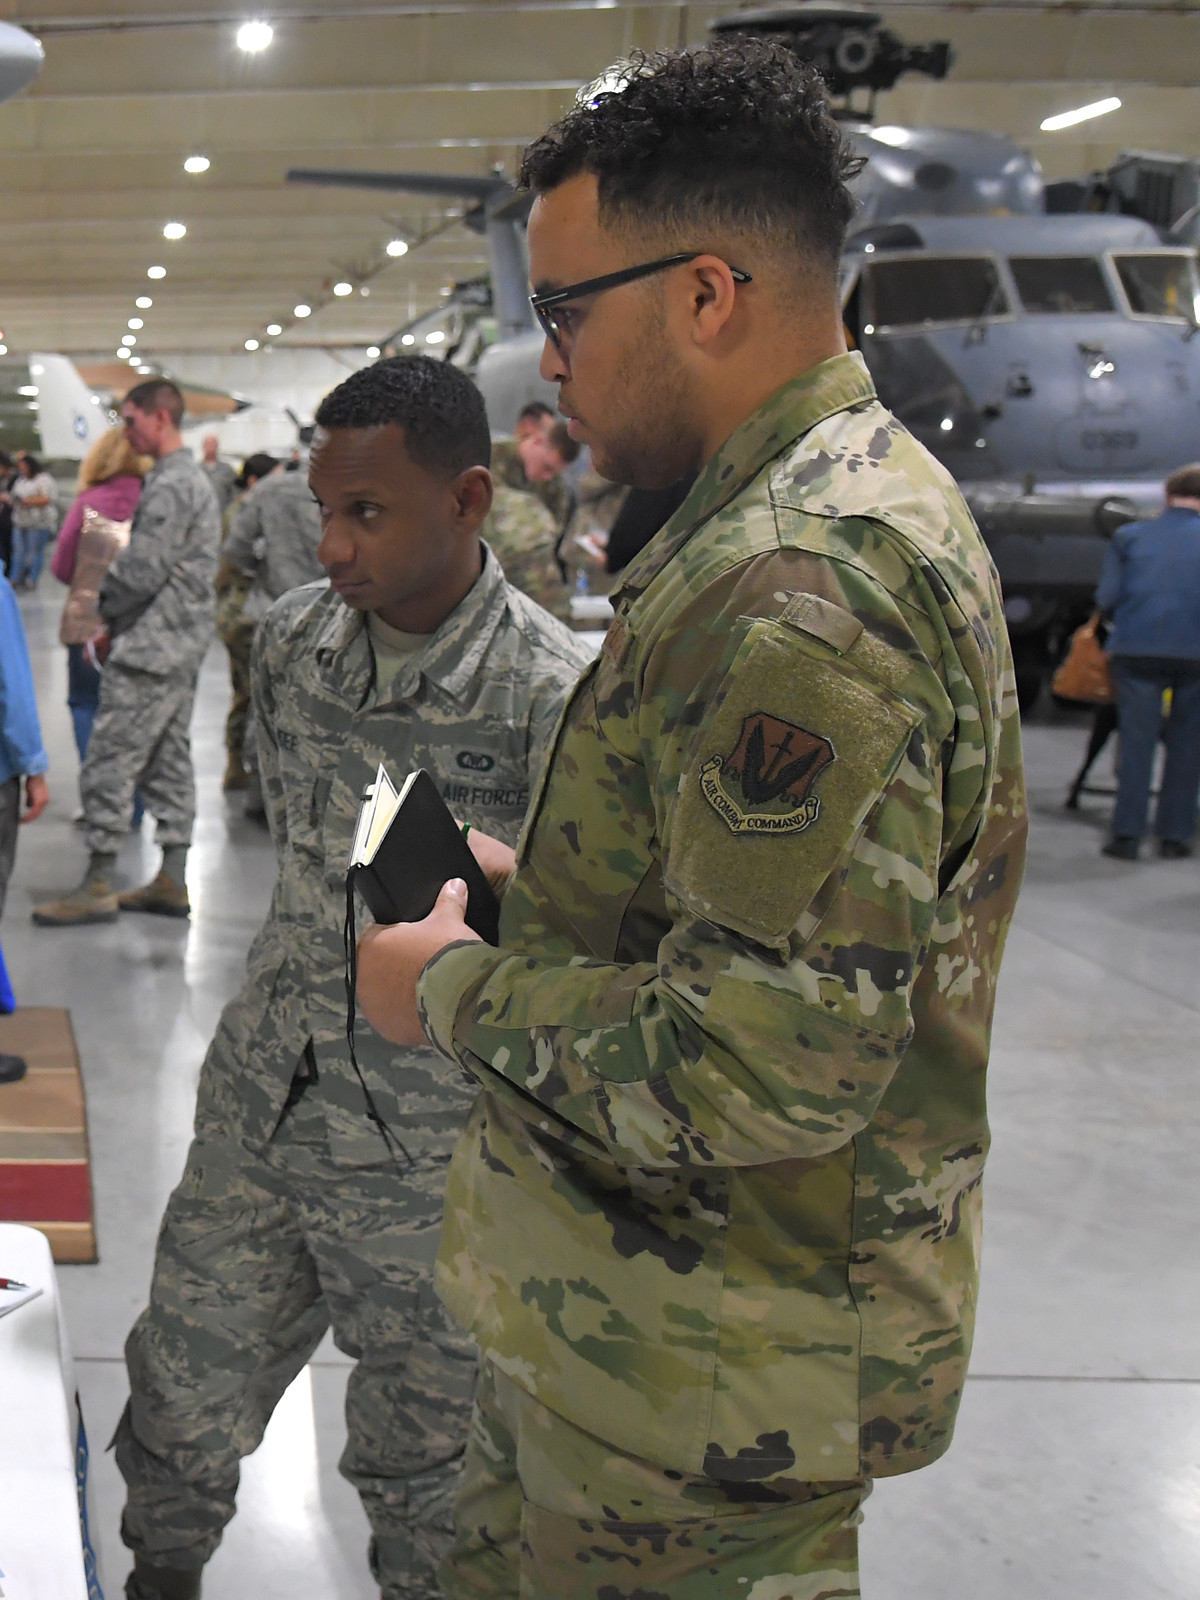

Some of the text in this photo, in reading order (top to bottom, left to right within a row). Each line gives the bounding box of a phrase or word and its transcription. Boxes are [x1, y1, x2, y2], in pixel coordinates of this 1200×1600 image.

[441, 784, 529, 806] AIR FORCE
[704, 778, 805, 830] AIR COMBAT COMMAND
